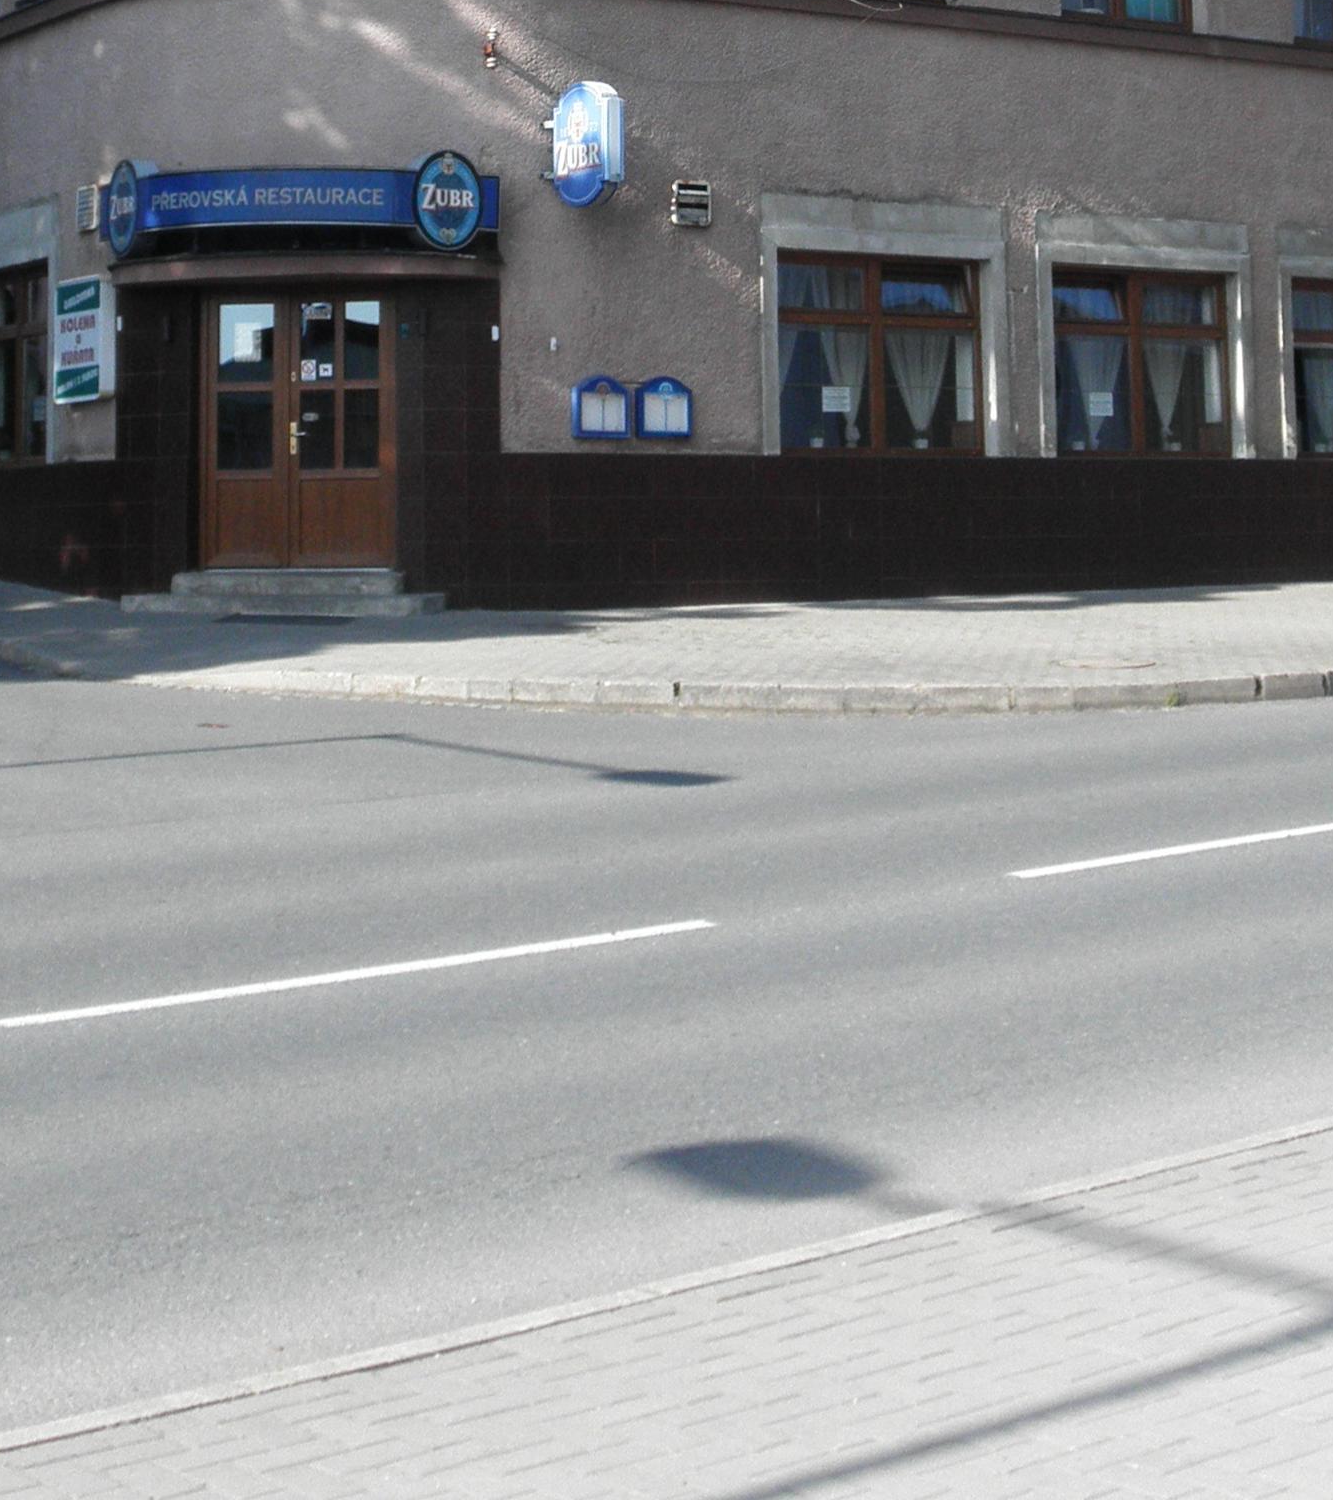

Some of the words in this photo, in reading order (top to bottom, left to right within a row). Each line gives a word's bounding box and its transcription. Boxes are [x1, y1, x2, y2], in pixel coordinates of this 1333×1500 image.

[151, 185, 248, 212] PŘEROVSKÁ
[254, 186, 385, 207] RESTAURACE
[421, 183, 474, 210] ZUBR
